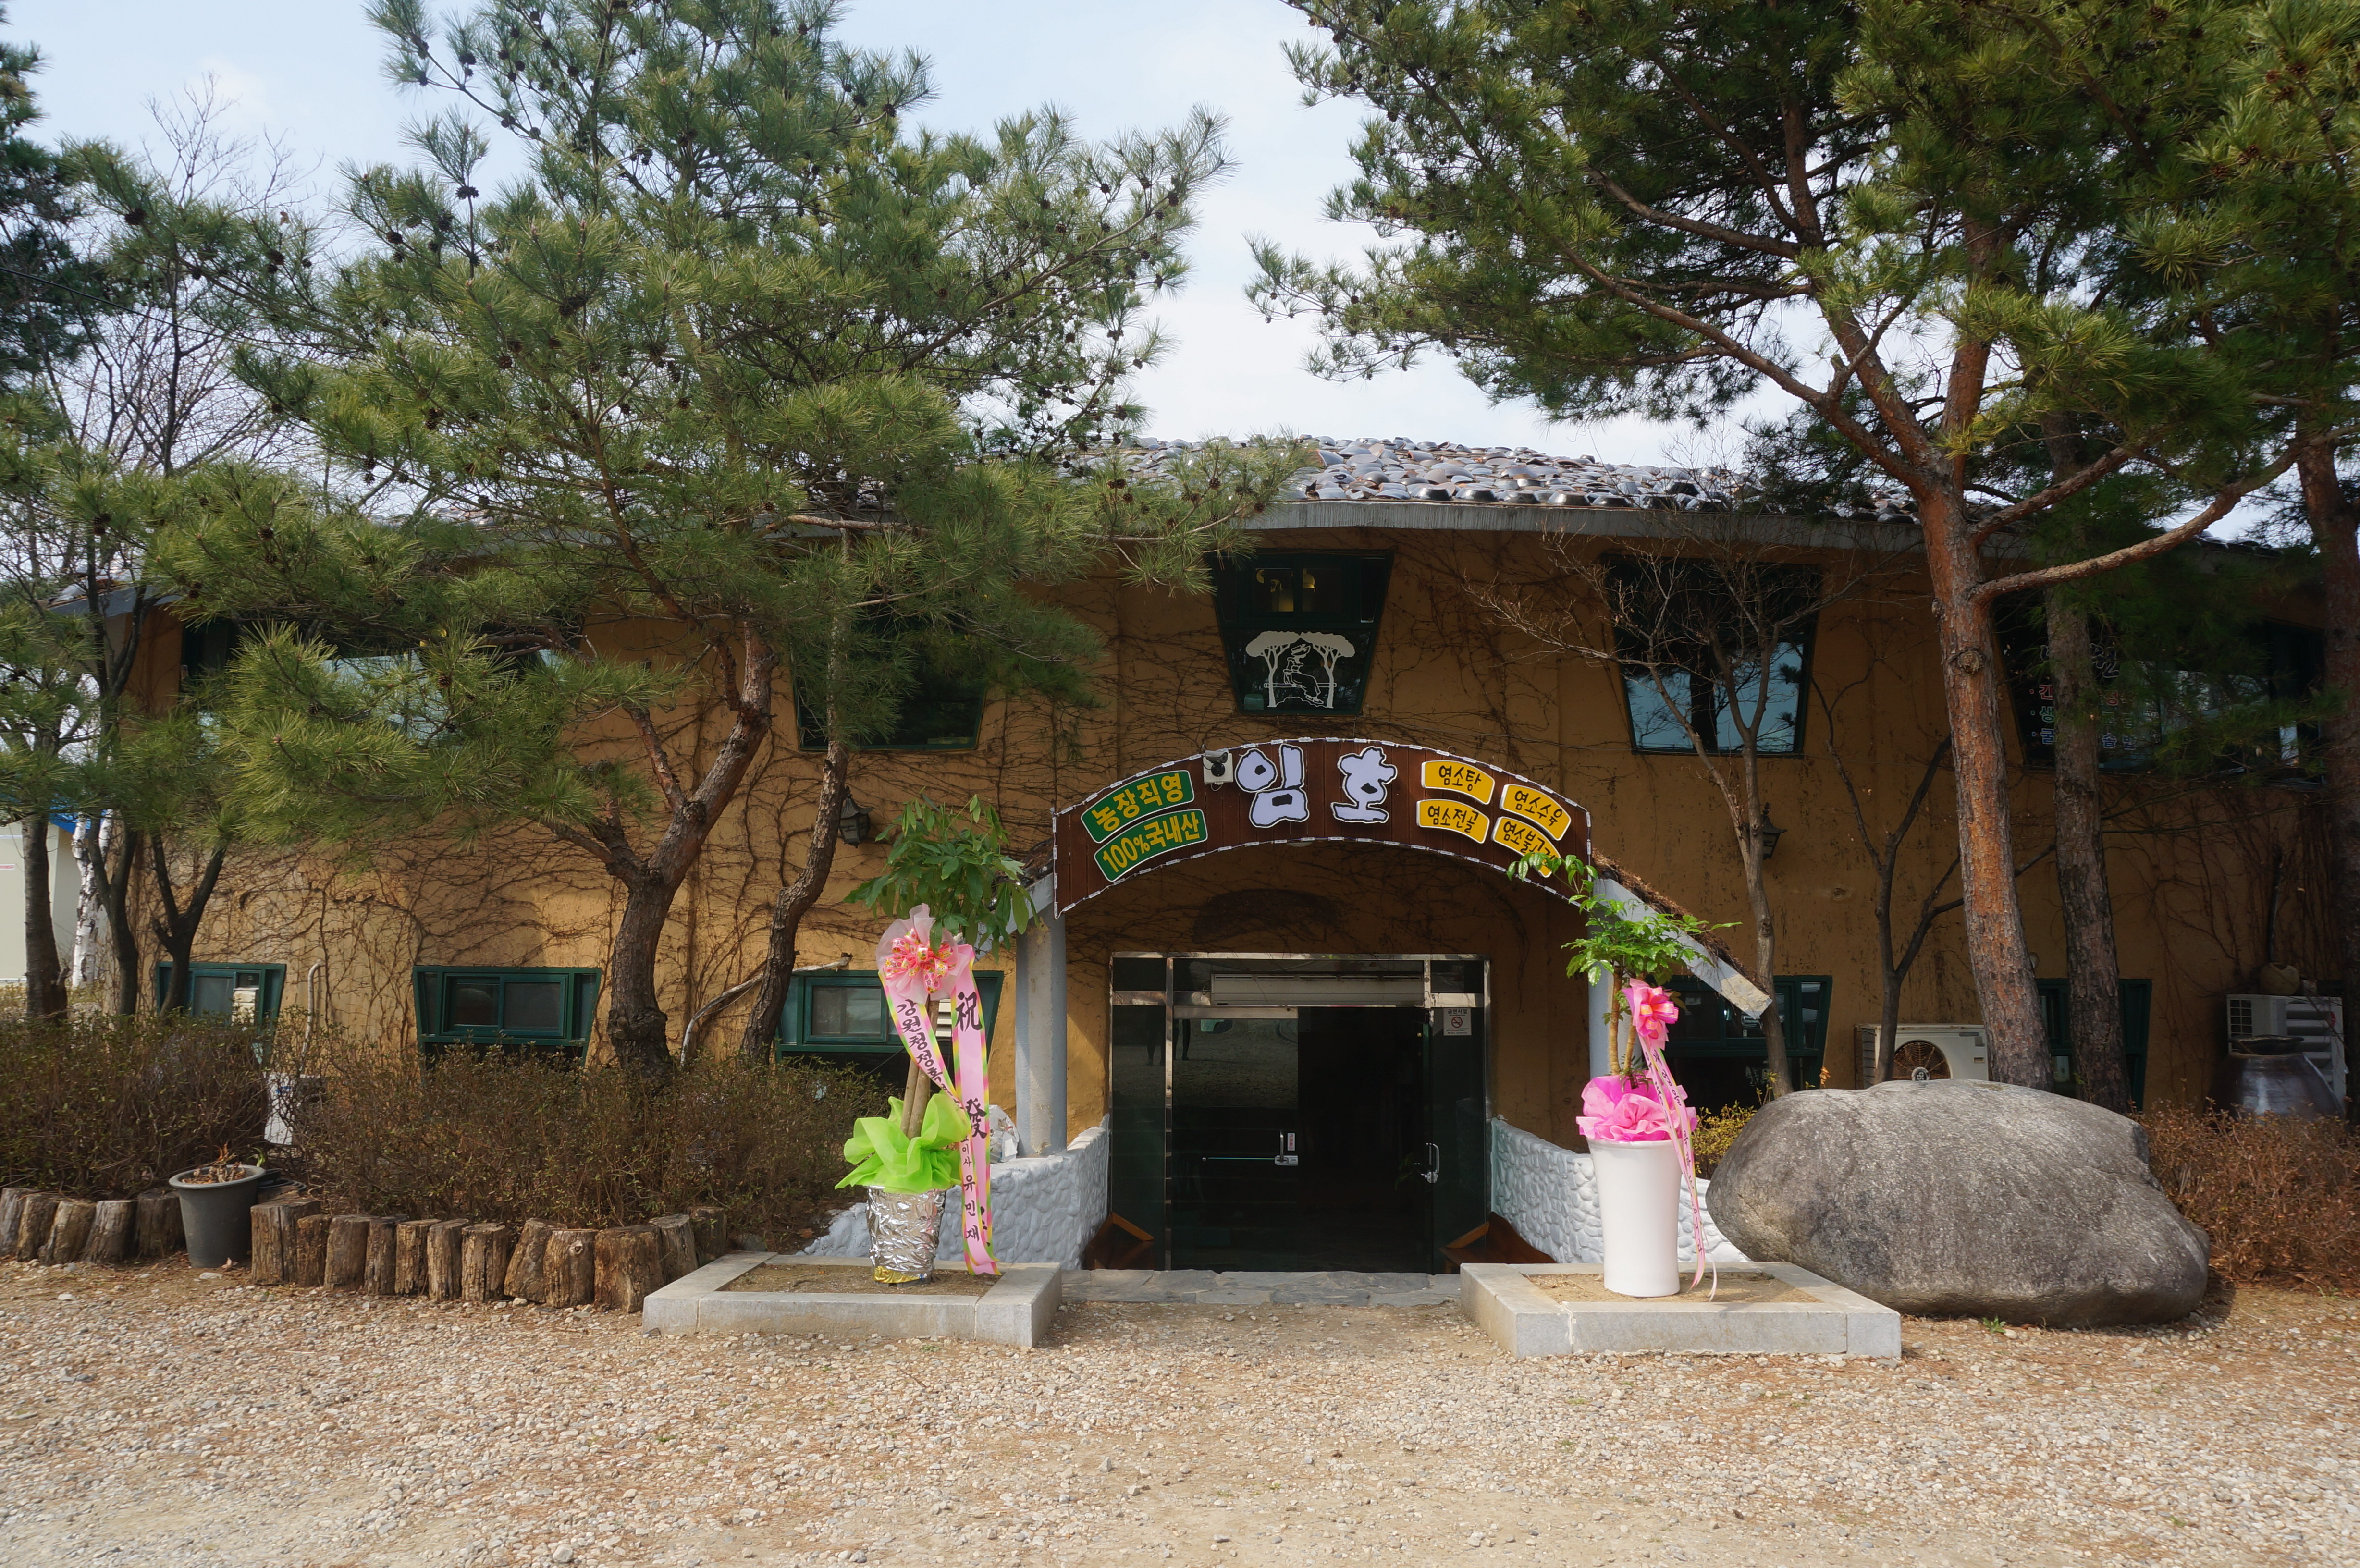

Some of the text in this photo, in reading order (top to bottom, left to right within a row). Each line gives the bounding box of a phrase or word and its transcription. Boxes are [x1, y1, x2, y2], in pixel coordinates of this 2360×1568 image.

[1438, 765, 1482, 792] 염소탕
[1091, 773, 1183, 832] 농장직영
[1428, 805, 1479, 833] 염소전골
[1514, 790, 1562, 826] 염소수육
[1102, 812, 1200, 873] 100%국내산
